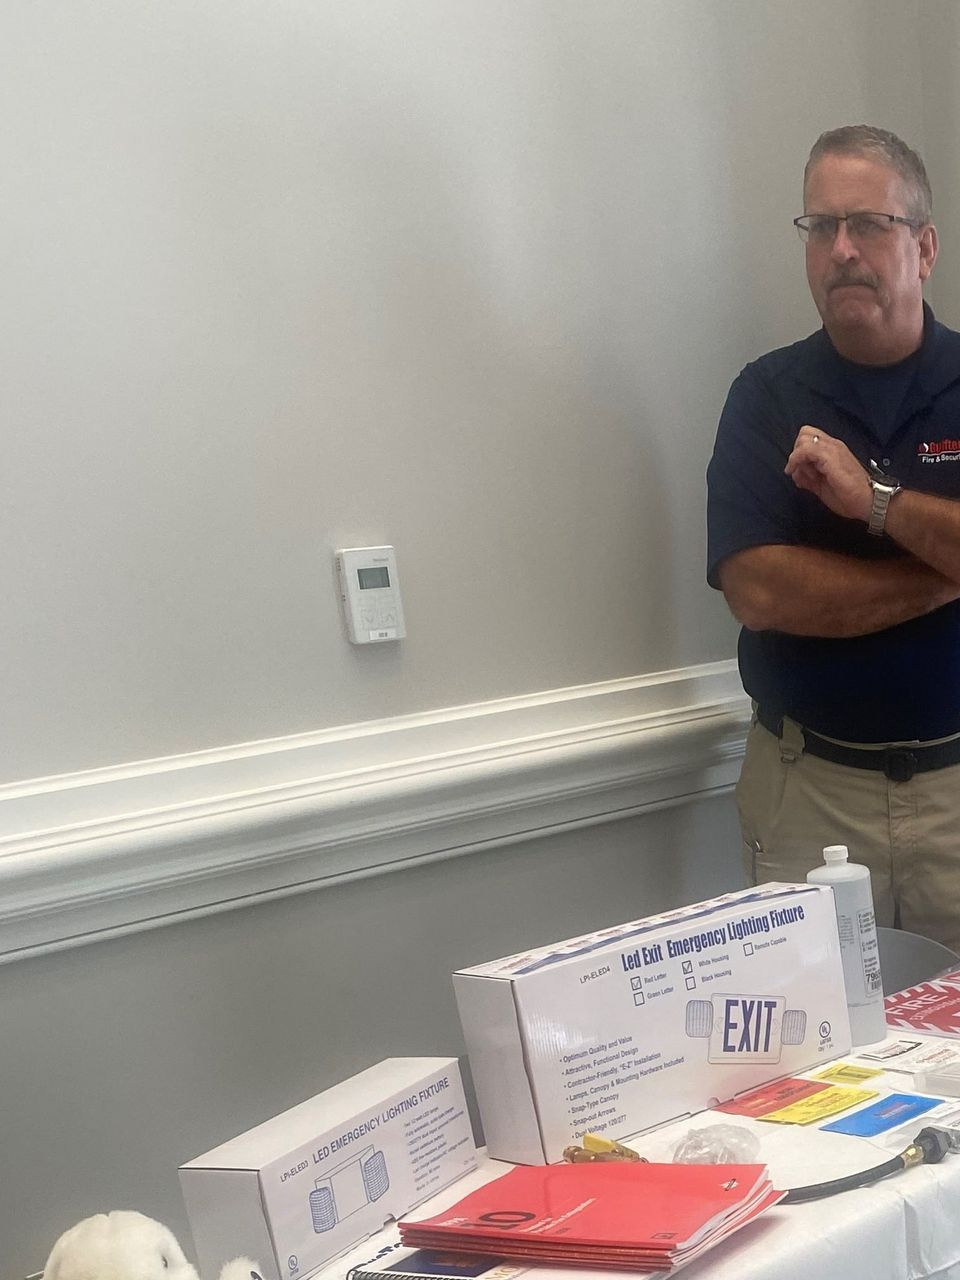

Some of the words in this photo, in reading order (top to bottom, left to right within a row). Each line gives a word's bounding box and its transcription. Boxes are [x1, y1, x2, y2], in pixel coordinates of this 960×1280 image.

[621, 950, 641, 972] Led
[642, 944, 664, 966] Exit
[666, 927, 727, 958] Emergency
[727, 915, 770, 942] Lighting
[769, 904, 805, 930] Fixture
[712, 955, 730, 963] Housing
[580, 965, 611, 984] LPI-ELED4
[885, 993, 948, 1015] FIRE
[723, 999, 777, 1052] EXIT
[563, 1050, 588, 1063] Optimum
[589, 1044, 607, 1055] Quality
[608, 1040, 618, 1048] and
[618, 1036, 632, 1045] Value
[634, 1053, 661, 1066] Installation
[565, 1063, 592, 1075] Attractive,
[593, 1052, 620, 1067] Functional
[621, 1047, 638, 1058] Design
[590, 1083, 610, 1095] Canopy
[615, 1073, 640, 1085] Mounting
[640, 1065, 663, 1076] Hardware
[664, 1057, 685, 1068] Included
[571, 1100, 599, 1114] Snap-Type
[600, 1093, 619, 1104] Canopy
[573, 1114, 597, 1126] Snap-out
[598, 1107, 616, 1117] Arrows
[588, 1122, 607, 1133] Voltage
[280, 1159, 309, 1183] LPI-ELED3
[312, 1143, 330, 1165] LED
[331, 1115, 381, 1153] EMERGENCY
[381, 1095, 419, 1124] LIGHTING
[418, 1076, 450, 1102] FIXTURE
